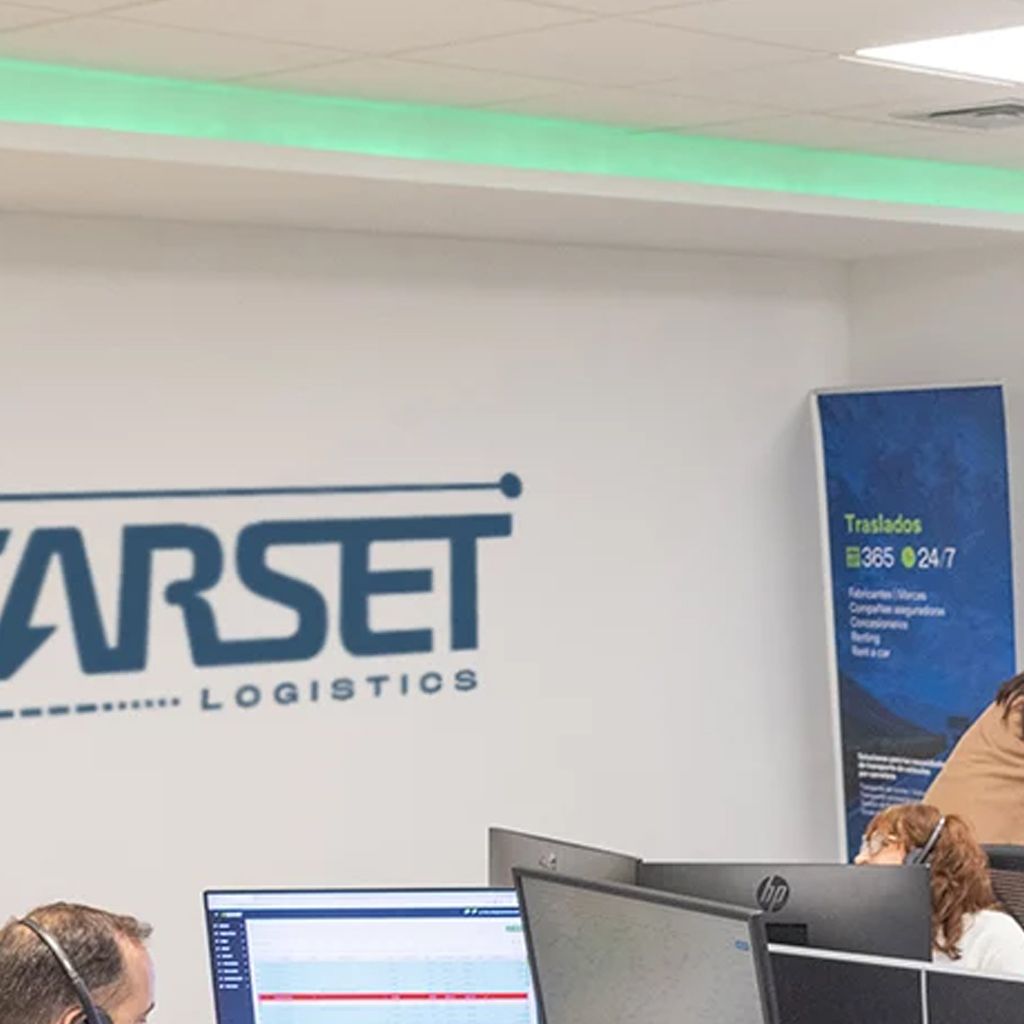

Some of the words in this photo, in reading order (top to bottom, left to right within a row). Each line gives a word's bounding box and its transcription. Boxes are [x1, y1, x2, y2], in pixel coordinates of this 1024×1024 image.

[844, 513, 923, 534] Traslados
[861, 546, 895, 568] 365
[917, 546, 957, 569] 24/7
[0, 513, 512, 681] ARSET
[200, 669, 480, 711] LOGISTICS
[758, 874, 788, 912] hp
